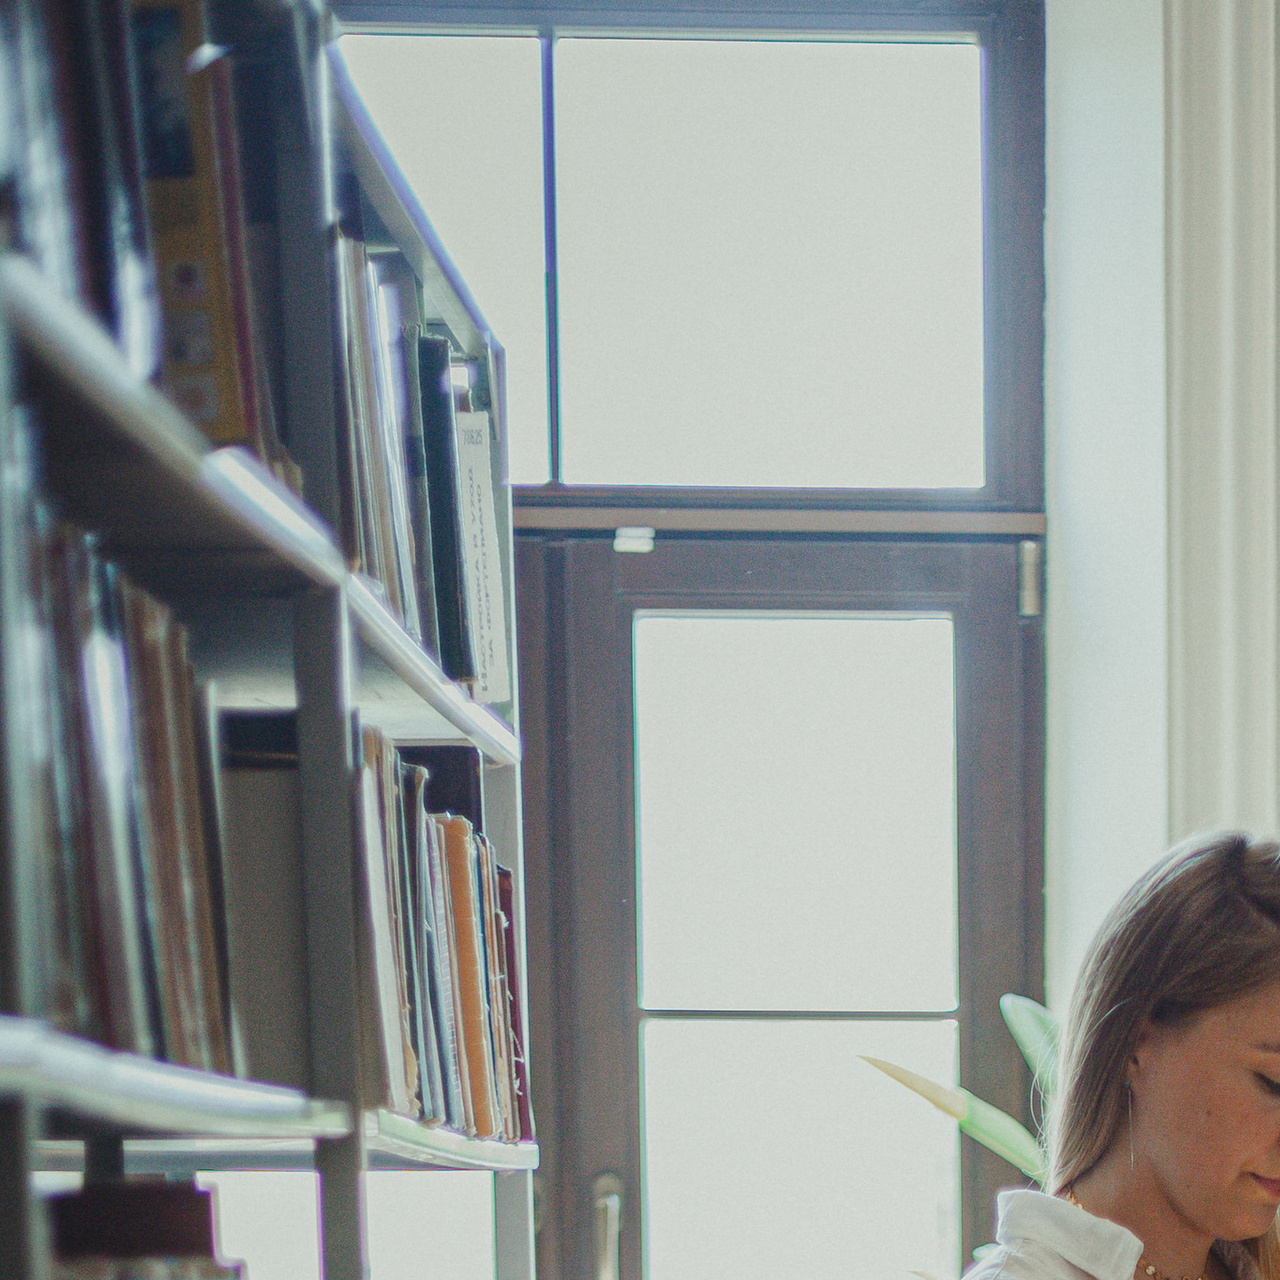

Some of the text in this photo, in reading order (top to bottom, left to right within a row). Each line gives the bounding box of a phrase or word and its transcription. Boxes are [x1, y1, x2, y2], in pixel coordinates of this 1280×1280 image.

[466, 464, 489, 692] НАСТРОЙКА И УХОД
[475, 483, 495, 668] ЗА ФОРТЕПИАНО
